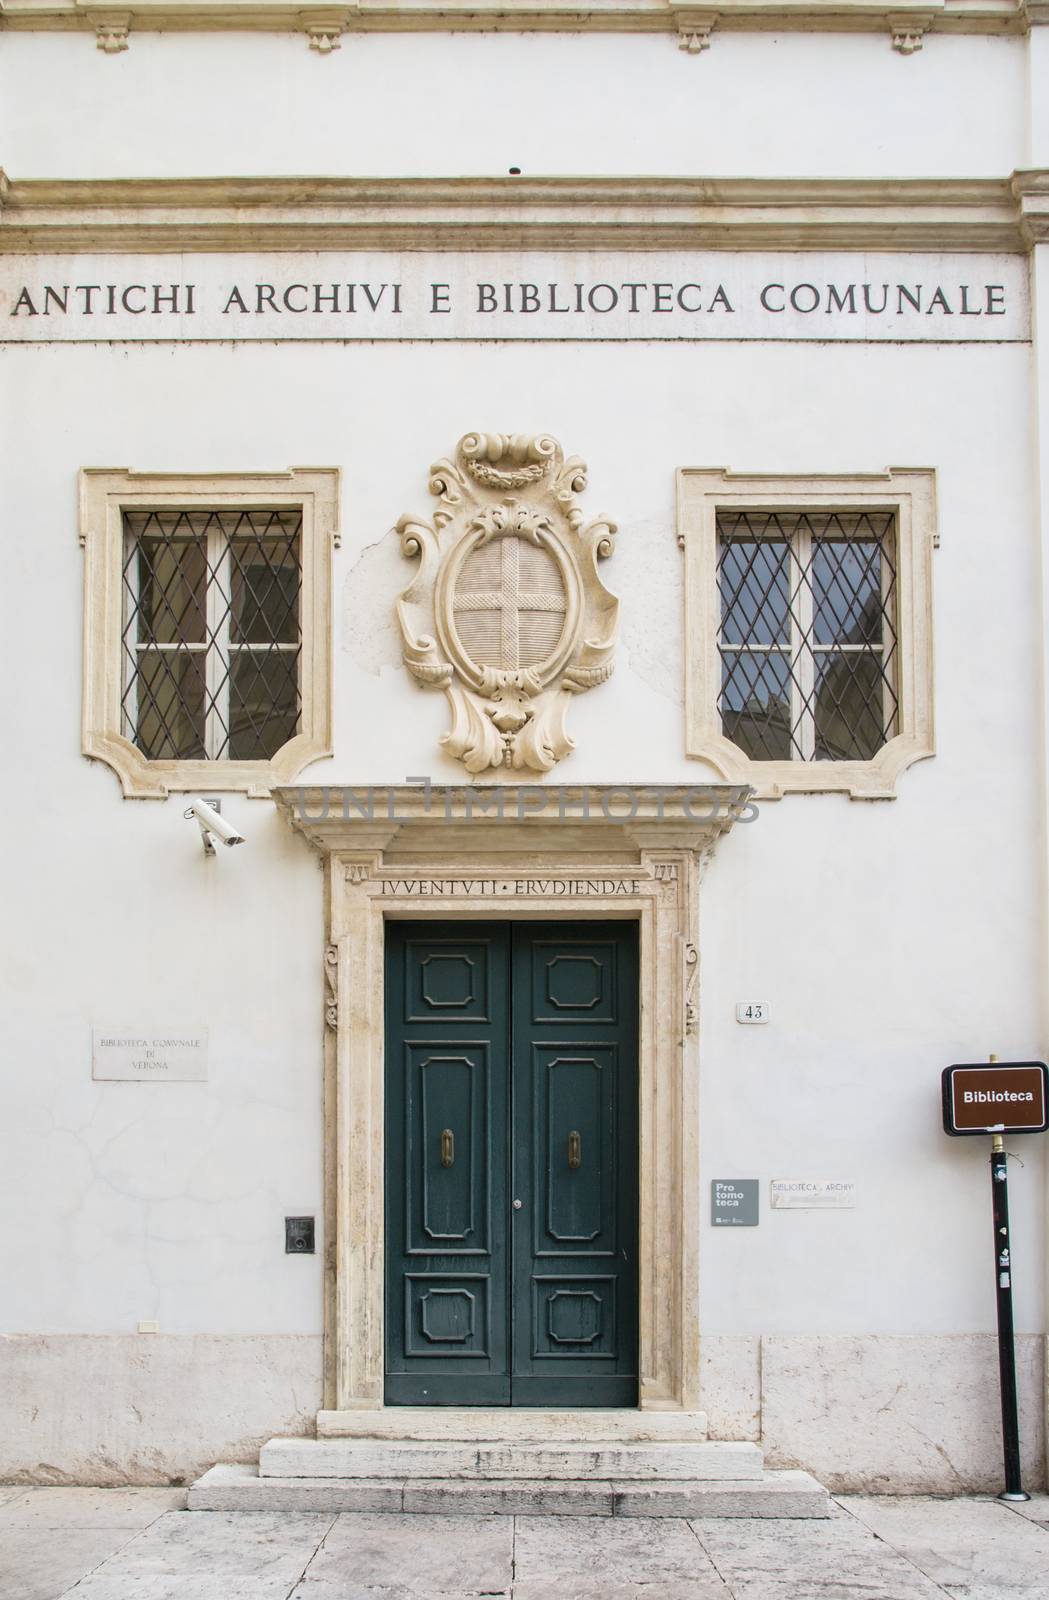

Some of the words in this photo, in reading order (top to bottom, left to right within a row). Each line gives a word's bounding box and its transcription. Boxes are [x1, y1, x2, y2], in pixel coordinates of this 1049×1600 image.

[10, 285, 196, 316] ANTICHI
[221, 284, 402, 314] ARCHIVI
[430, 284, 451, 313] E
[476, 283, 735, 314] BIBLIOTECA
[760, 283, 1006, 315] COMUNALE
[380, 879, 497, 896] IVVENTVTI
[514, 879, 641, 896] ERVDIENDAE
[745, 1005, 762, 1019] 43
[100, 1039, 148, 1048] BIBLIOTECA
[132, 1062, 169, 1070] VERONA
[963, 1090, 1034, 1103] Biblioteca
[715, 1183, 735, 1192] Pro
[715, 1199, 739, 1207] teca
